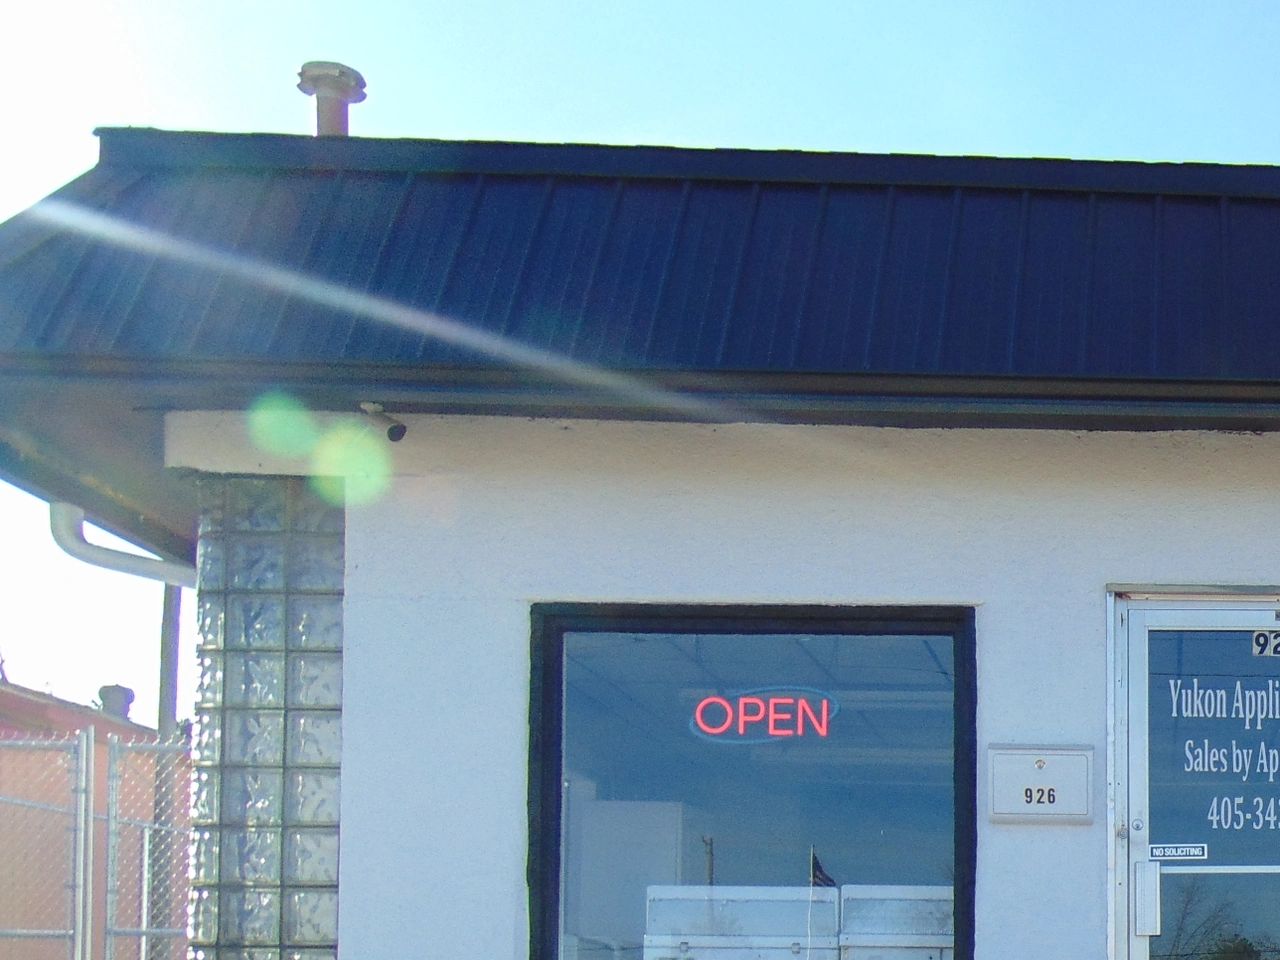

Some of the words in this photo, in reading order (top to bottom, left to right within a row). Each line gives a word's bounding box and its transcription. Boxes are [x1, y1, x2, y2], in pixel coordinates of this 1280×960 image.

[695, 695, 830, 738] OPEN
[1168, 678, 1227, 719] Yukon
[1184, 738, 1228, 773] Sales
[1231, 740, 1253, 782] by
[1024, 787, 1056, 805] 926
[1152, 847, 1164, 857] NO
[1164, 847, 1203, 857] SOLICITING
